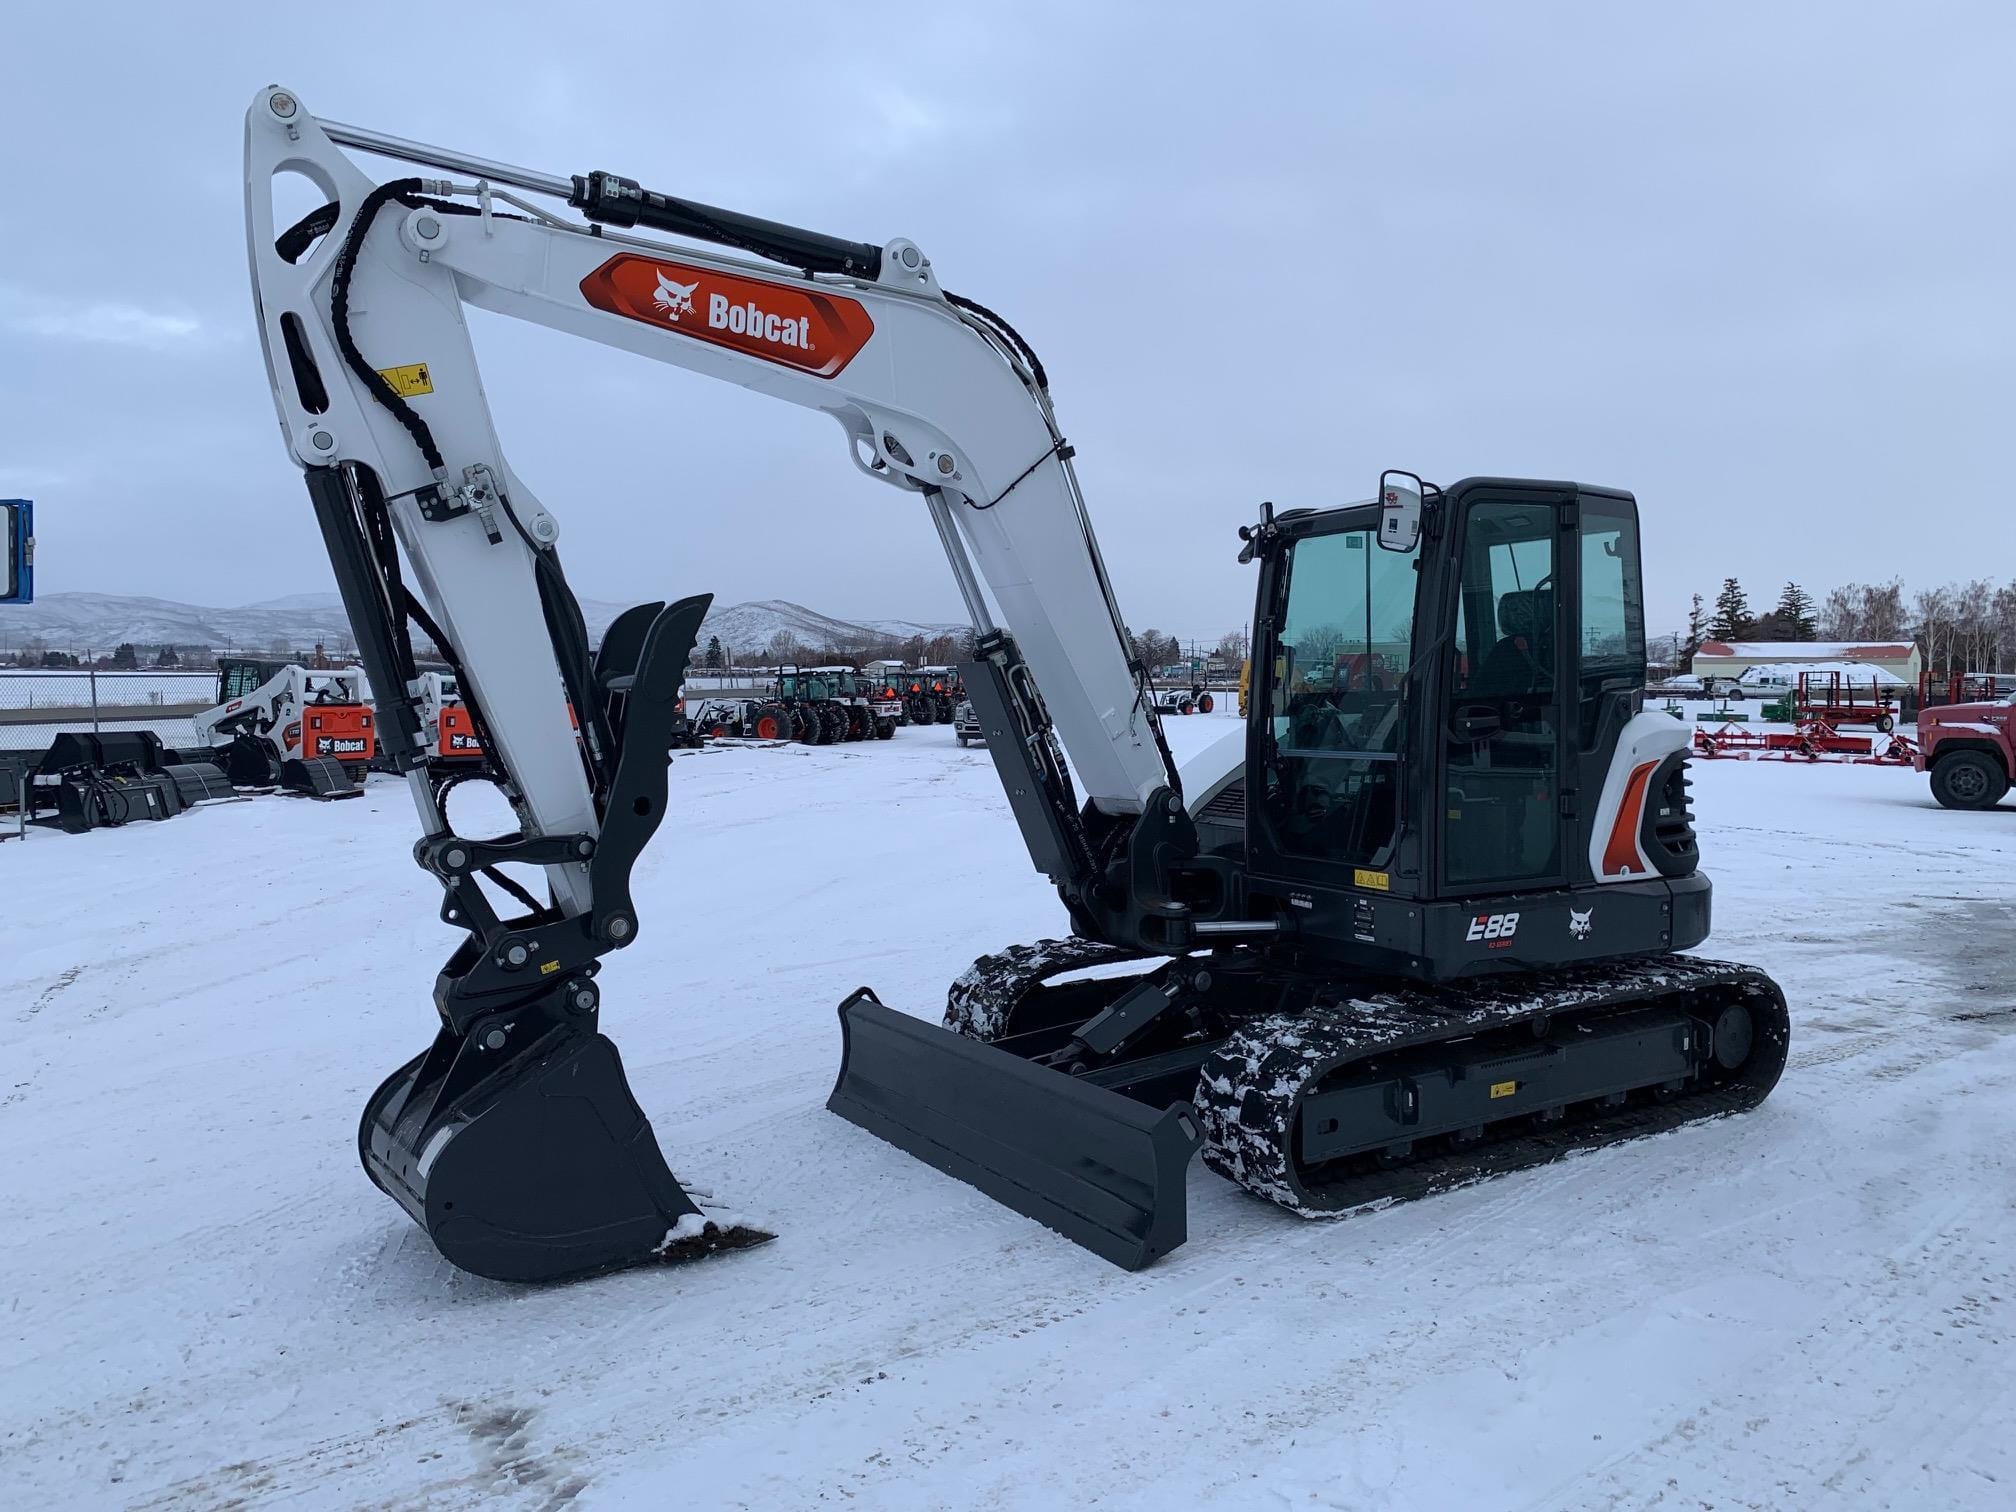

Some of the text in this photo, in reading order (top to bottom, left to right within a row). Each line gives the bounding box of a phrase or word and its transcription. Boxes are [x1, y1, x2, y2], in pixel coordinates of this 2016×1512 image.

[709, 293, 811, 350] Bobcat
[334, 739, 364, 752] Bobcat
[1465, 912, 1520, 942] E88
